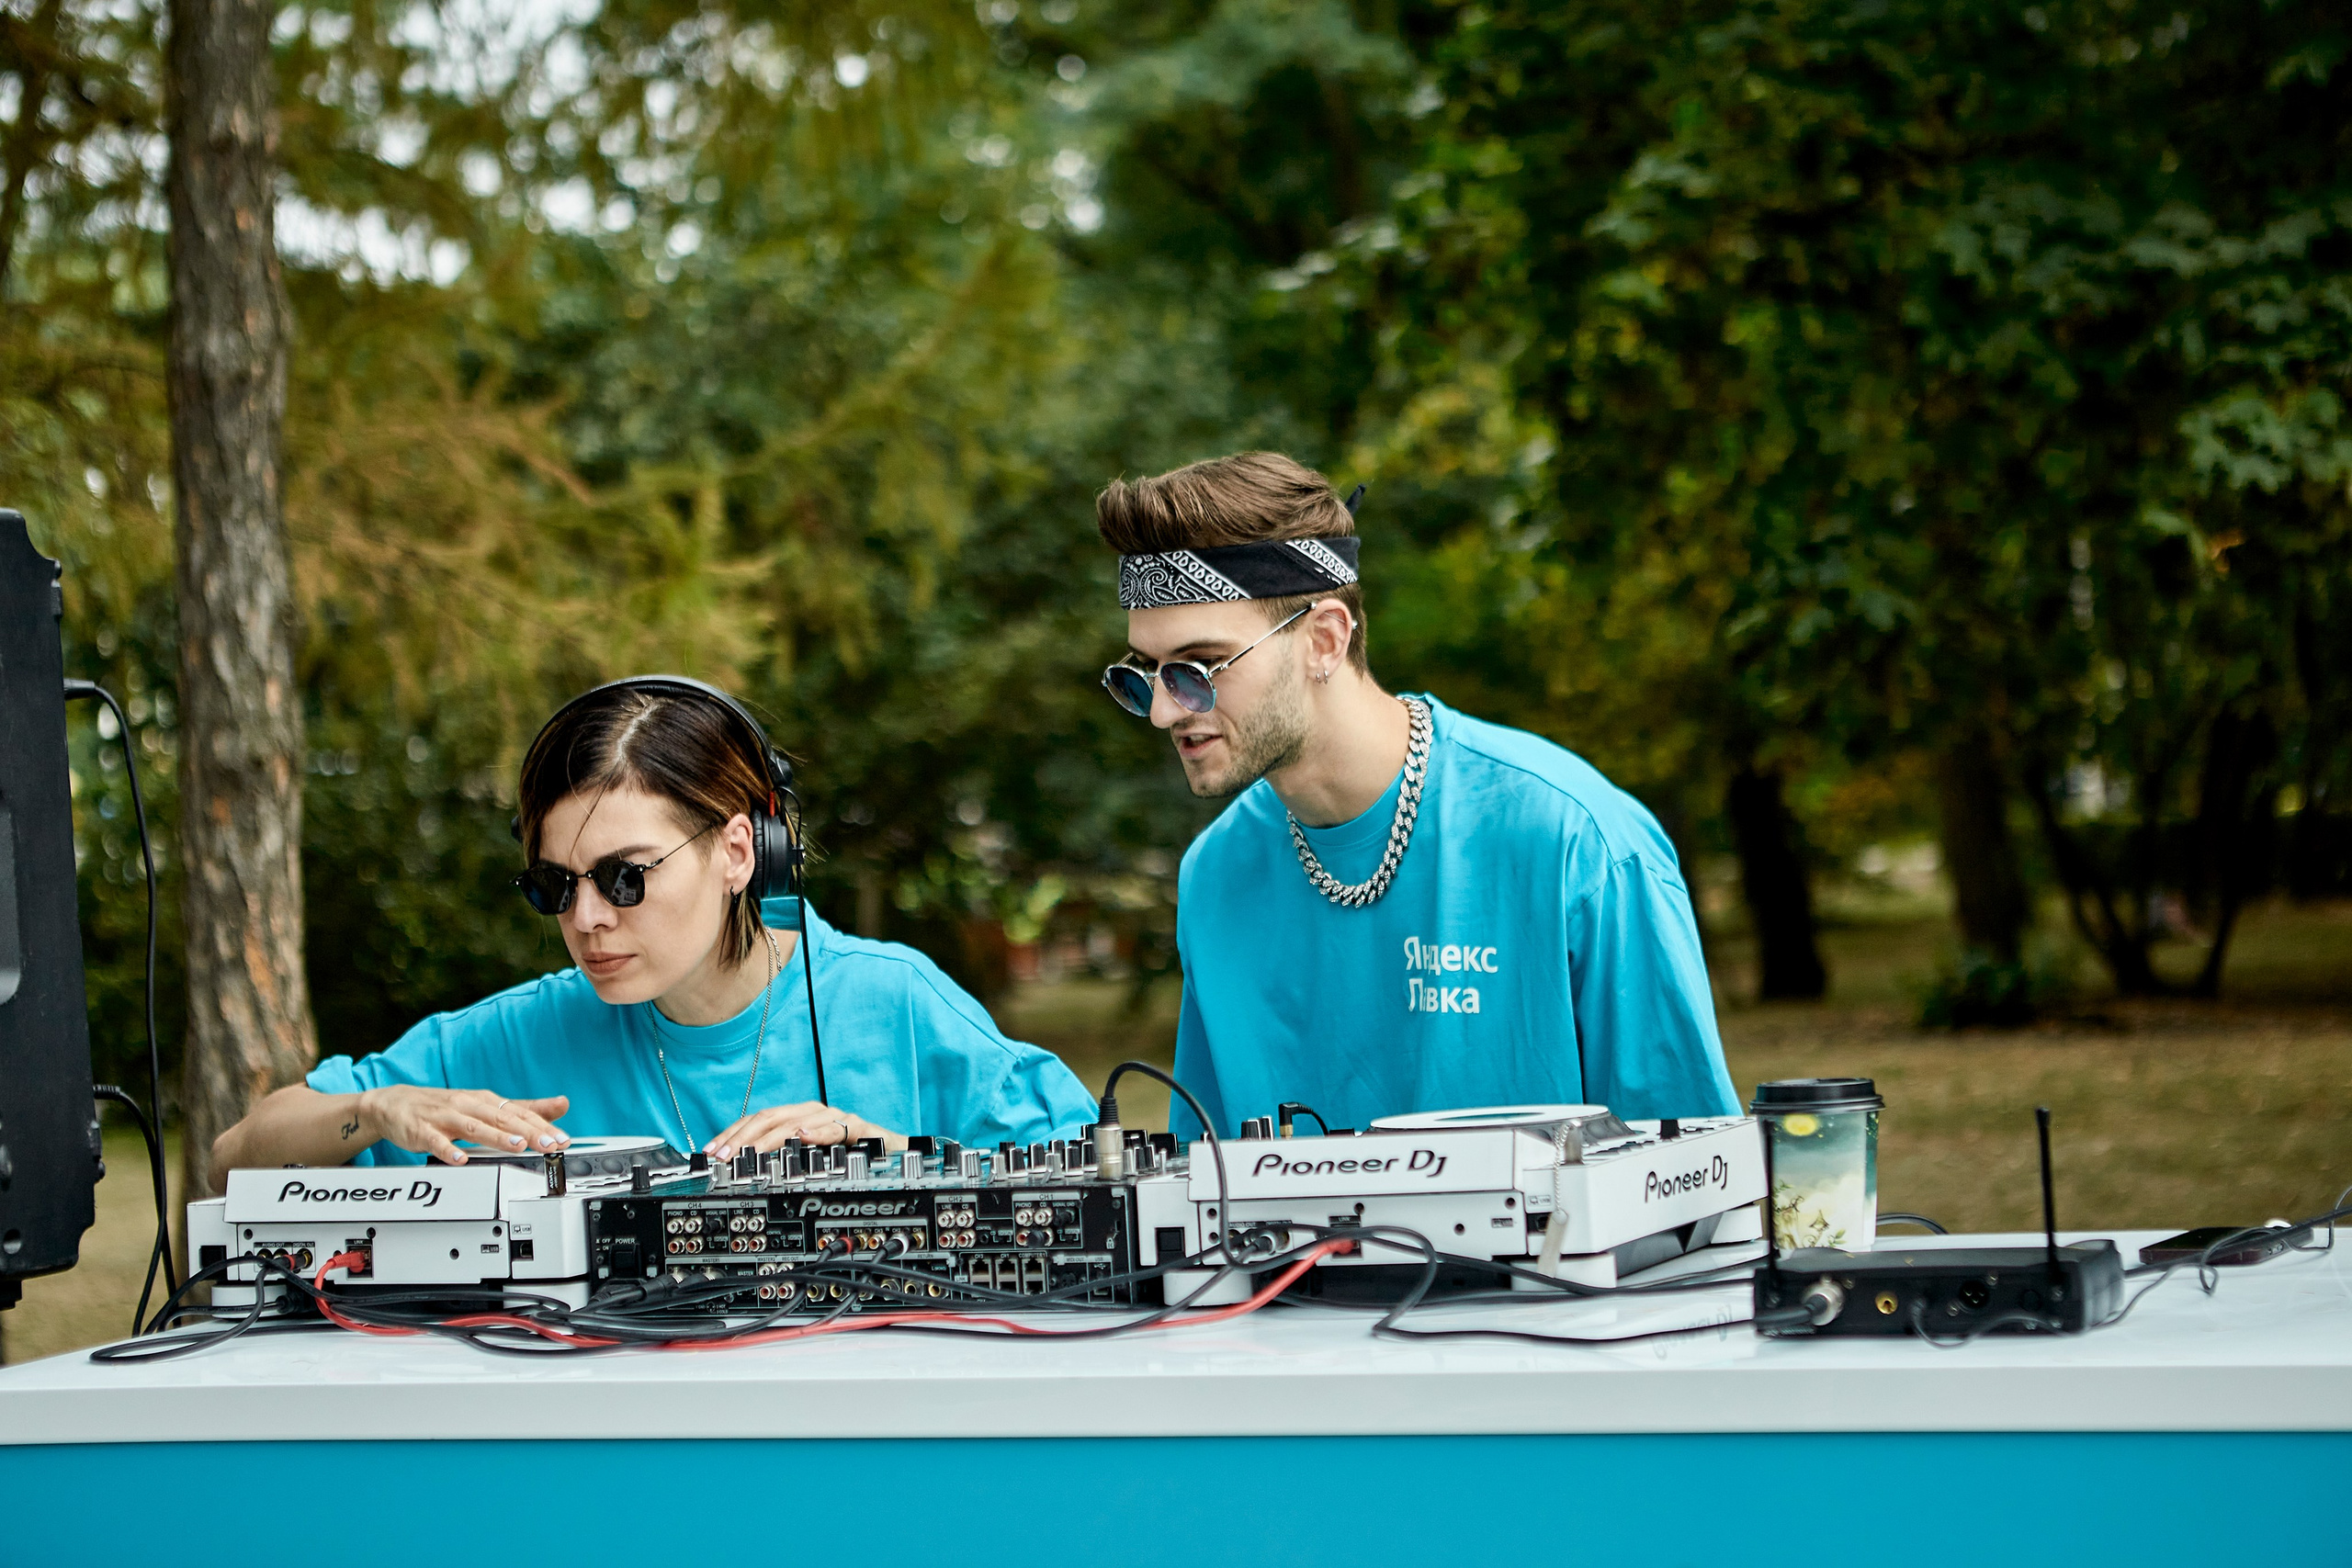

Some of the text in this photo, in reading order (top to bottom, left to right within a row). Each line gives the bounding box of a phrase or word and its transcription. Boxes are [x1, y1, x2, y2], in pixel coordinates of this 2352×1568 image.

[1404, 936, 1498, 976] Яндекс
[1408, 978, 1480, 1014] Лвка
[1252, 1154, 1399, 1177] Pioneer
[277, 1181, 402, 1202] Pioneer
[1645, 1168, 1708, 1202] Pioneer
[798, 1198, 907, 1217] Pioneer
